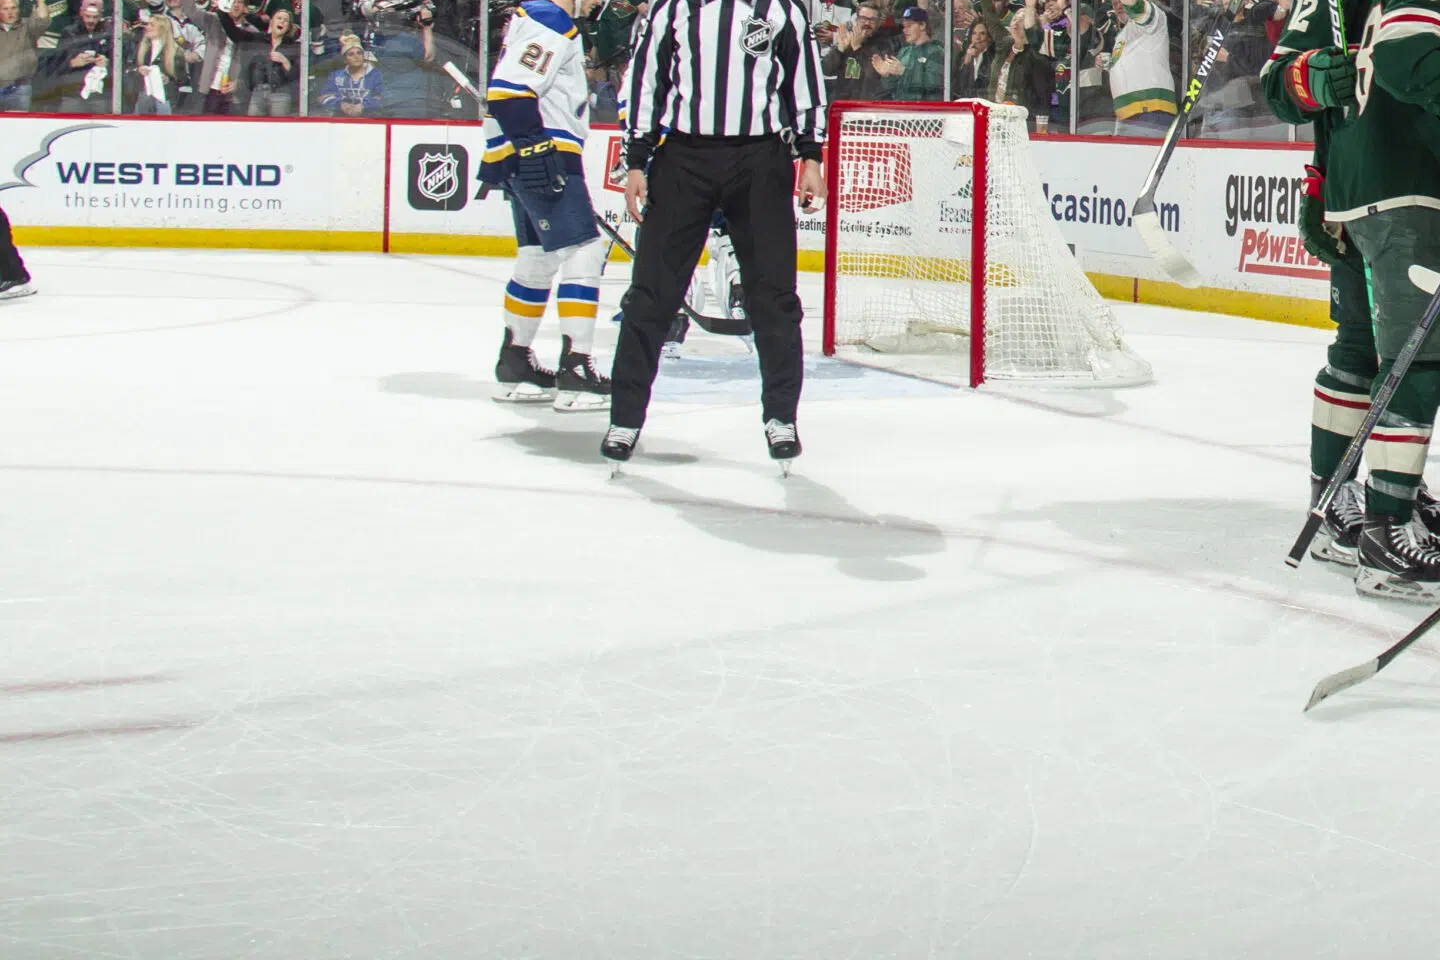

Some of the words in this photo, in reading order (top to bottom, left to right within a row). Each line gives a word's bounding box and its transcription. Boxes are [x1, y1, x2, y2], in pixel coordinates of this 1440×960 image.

[519, 42, 554, 74] 21
[1197, 29, 1225, 77] ALPHA
[519, 140, 557, 157] CC
[56, 161, 168, 185] WEST
[175, 163, 281, 187] BEND
[64, 192, 282, 213] thesilverlining.com
